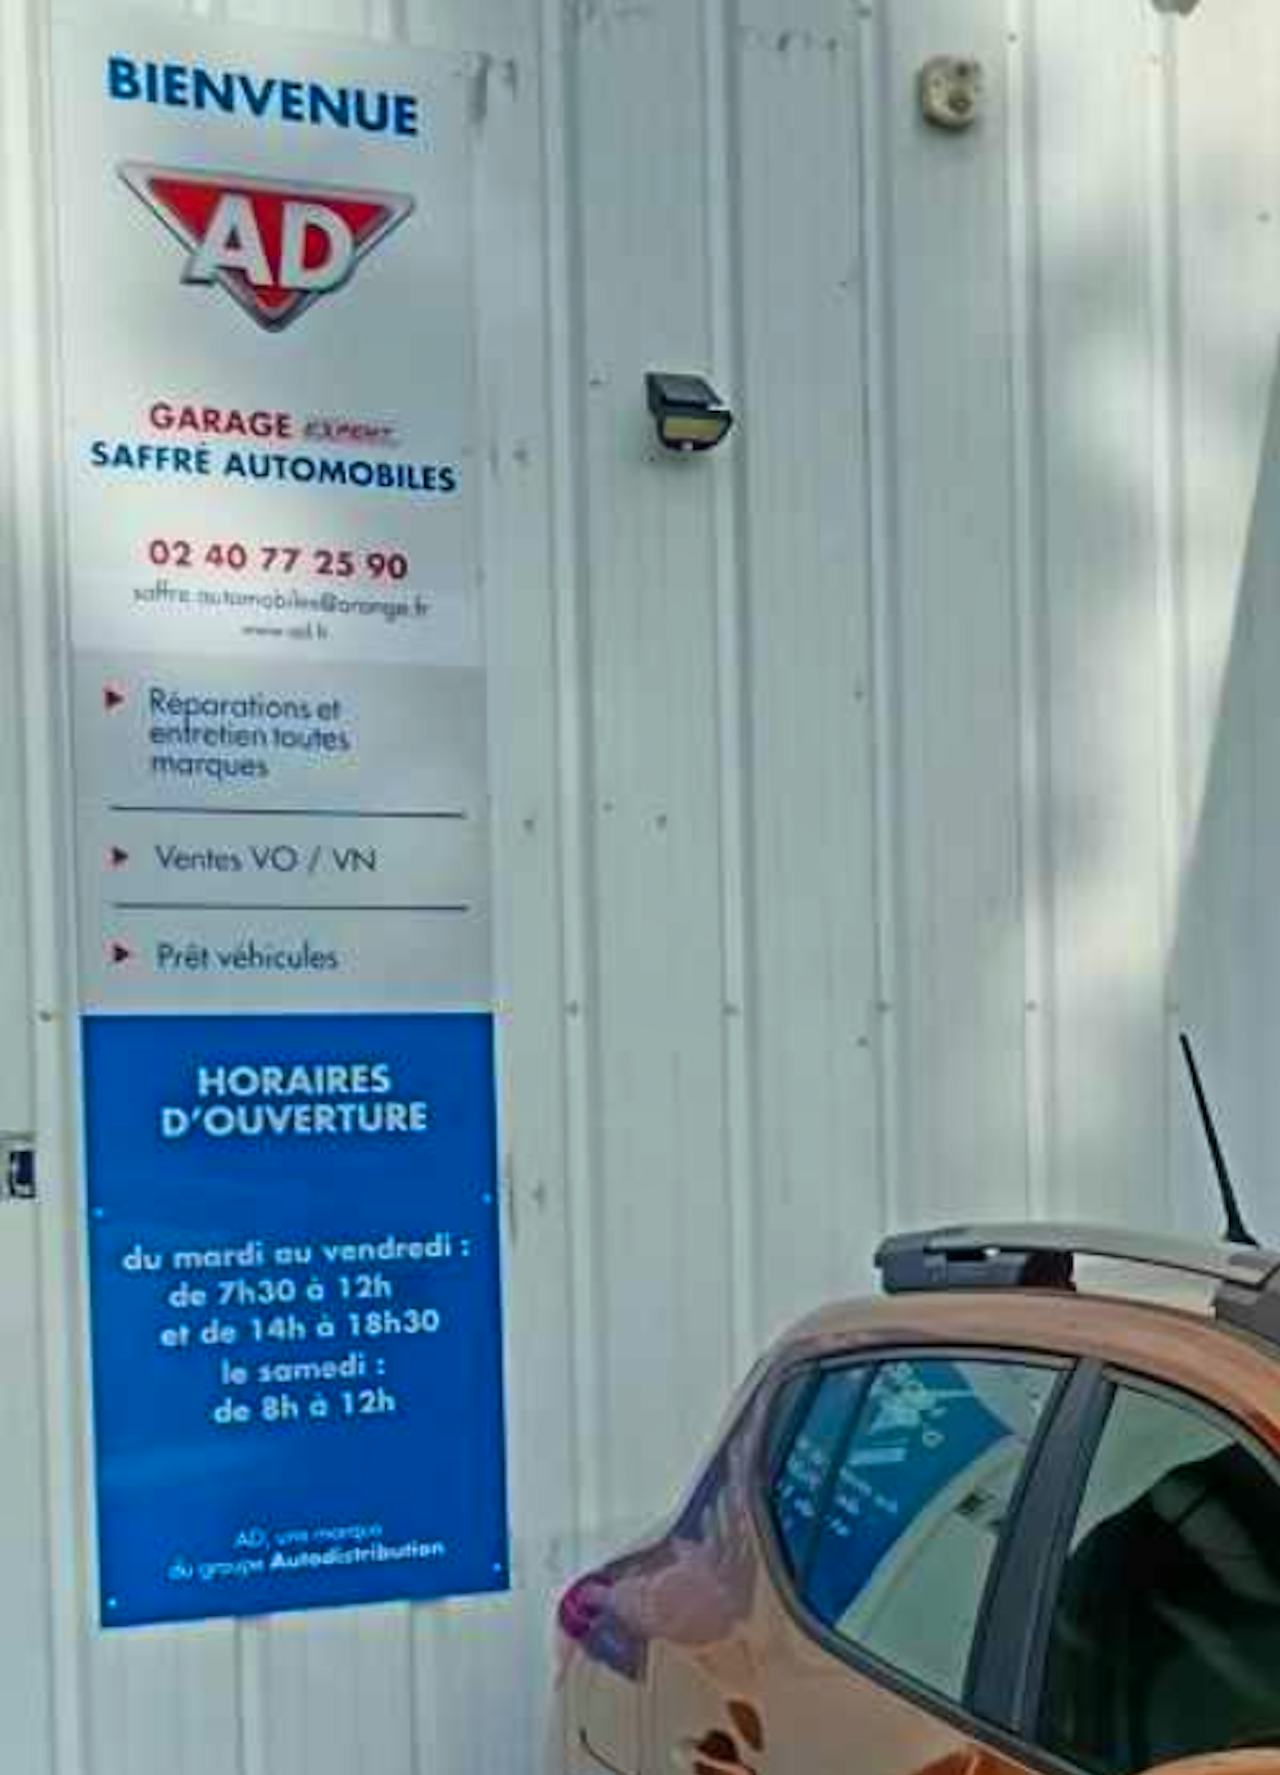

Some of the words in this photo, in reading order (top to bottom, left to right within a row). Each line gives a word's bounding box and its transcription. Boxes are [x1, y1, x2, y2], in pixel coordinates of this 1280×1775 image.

[107, 56, 419, 137] BIENVENUE
[183, 192, 355, 291] AD
[150, 403, 292, 438] GARAGE
[91, 440, 210, 474] SAFFRÉ
[224, 452, 456, 491] AUTOMOBILES
[150, 540, 191, 566] 02
[205, 543, 247, 570] 40
[260, 547, 300, 572] 77
[315, 550, 354, 577] 25
[366, 553, 408, 580] 90
[149, 688, 311, 729] Réparations
[317, 699, 340, 720] et
[150, 723, 268, 748] entretien
[273, 727, 351, 752] toutes
[151, 755, 269, 782] marques
[154, 845, 242, 873] Ventes
[252, 847, 298, 872] VO
[307, 846, 322, 874] /
[333, 847, 377, 872] VN
[157, 942, 207, 970] Prêt
[219, 941, 339, 970] véhicules
[198, 1064, 391, 1097] HORAIRES
[162, 1102, 428, 1137] D'OUVERTURE
[123, 1245, 161, 1271] du
[173, 1240, 265, 1269] mardi
[274, 1246, 312, 1266] au
[324, 1233, 453, 1263] vendredi
[169, 1283, 207, 1309] de
[218, 1278, 296, 1306] 7h30
[307, 1277, 324, 1302] à
[339, 1274, 393, 1301] 12h
[160, 1324, 190, 1348] et
[201, 1317, 237, 1346] de
[251, 1315, 305, 1343] 14h
[317, 1312, 336, 1339] à
[349, 1308, 440, 1337] 18h30
[221, 1358, 247, 1386] le
[257, 1352, 366, 1383] samedi
[214, 1397, 251, 1425] de
[262, 1393, 299, 1421] 8h
[310, 1390, 328, 1418] à
[344, 1388, 397, 1417] 12h
[168, 1556, 194, 1580] du
[269, 1540, 446, 1570] Autodistribution
